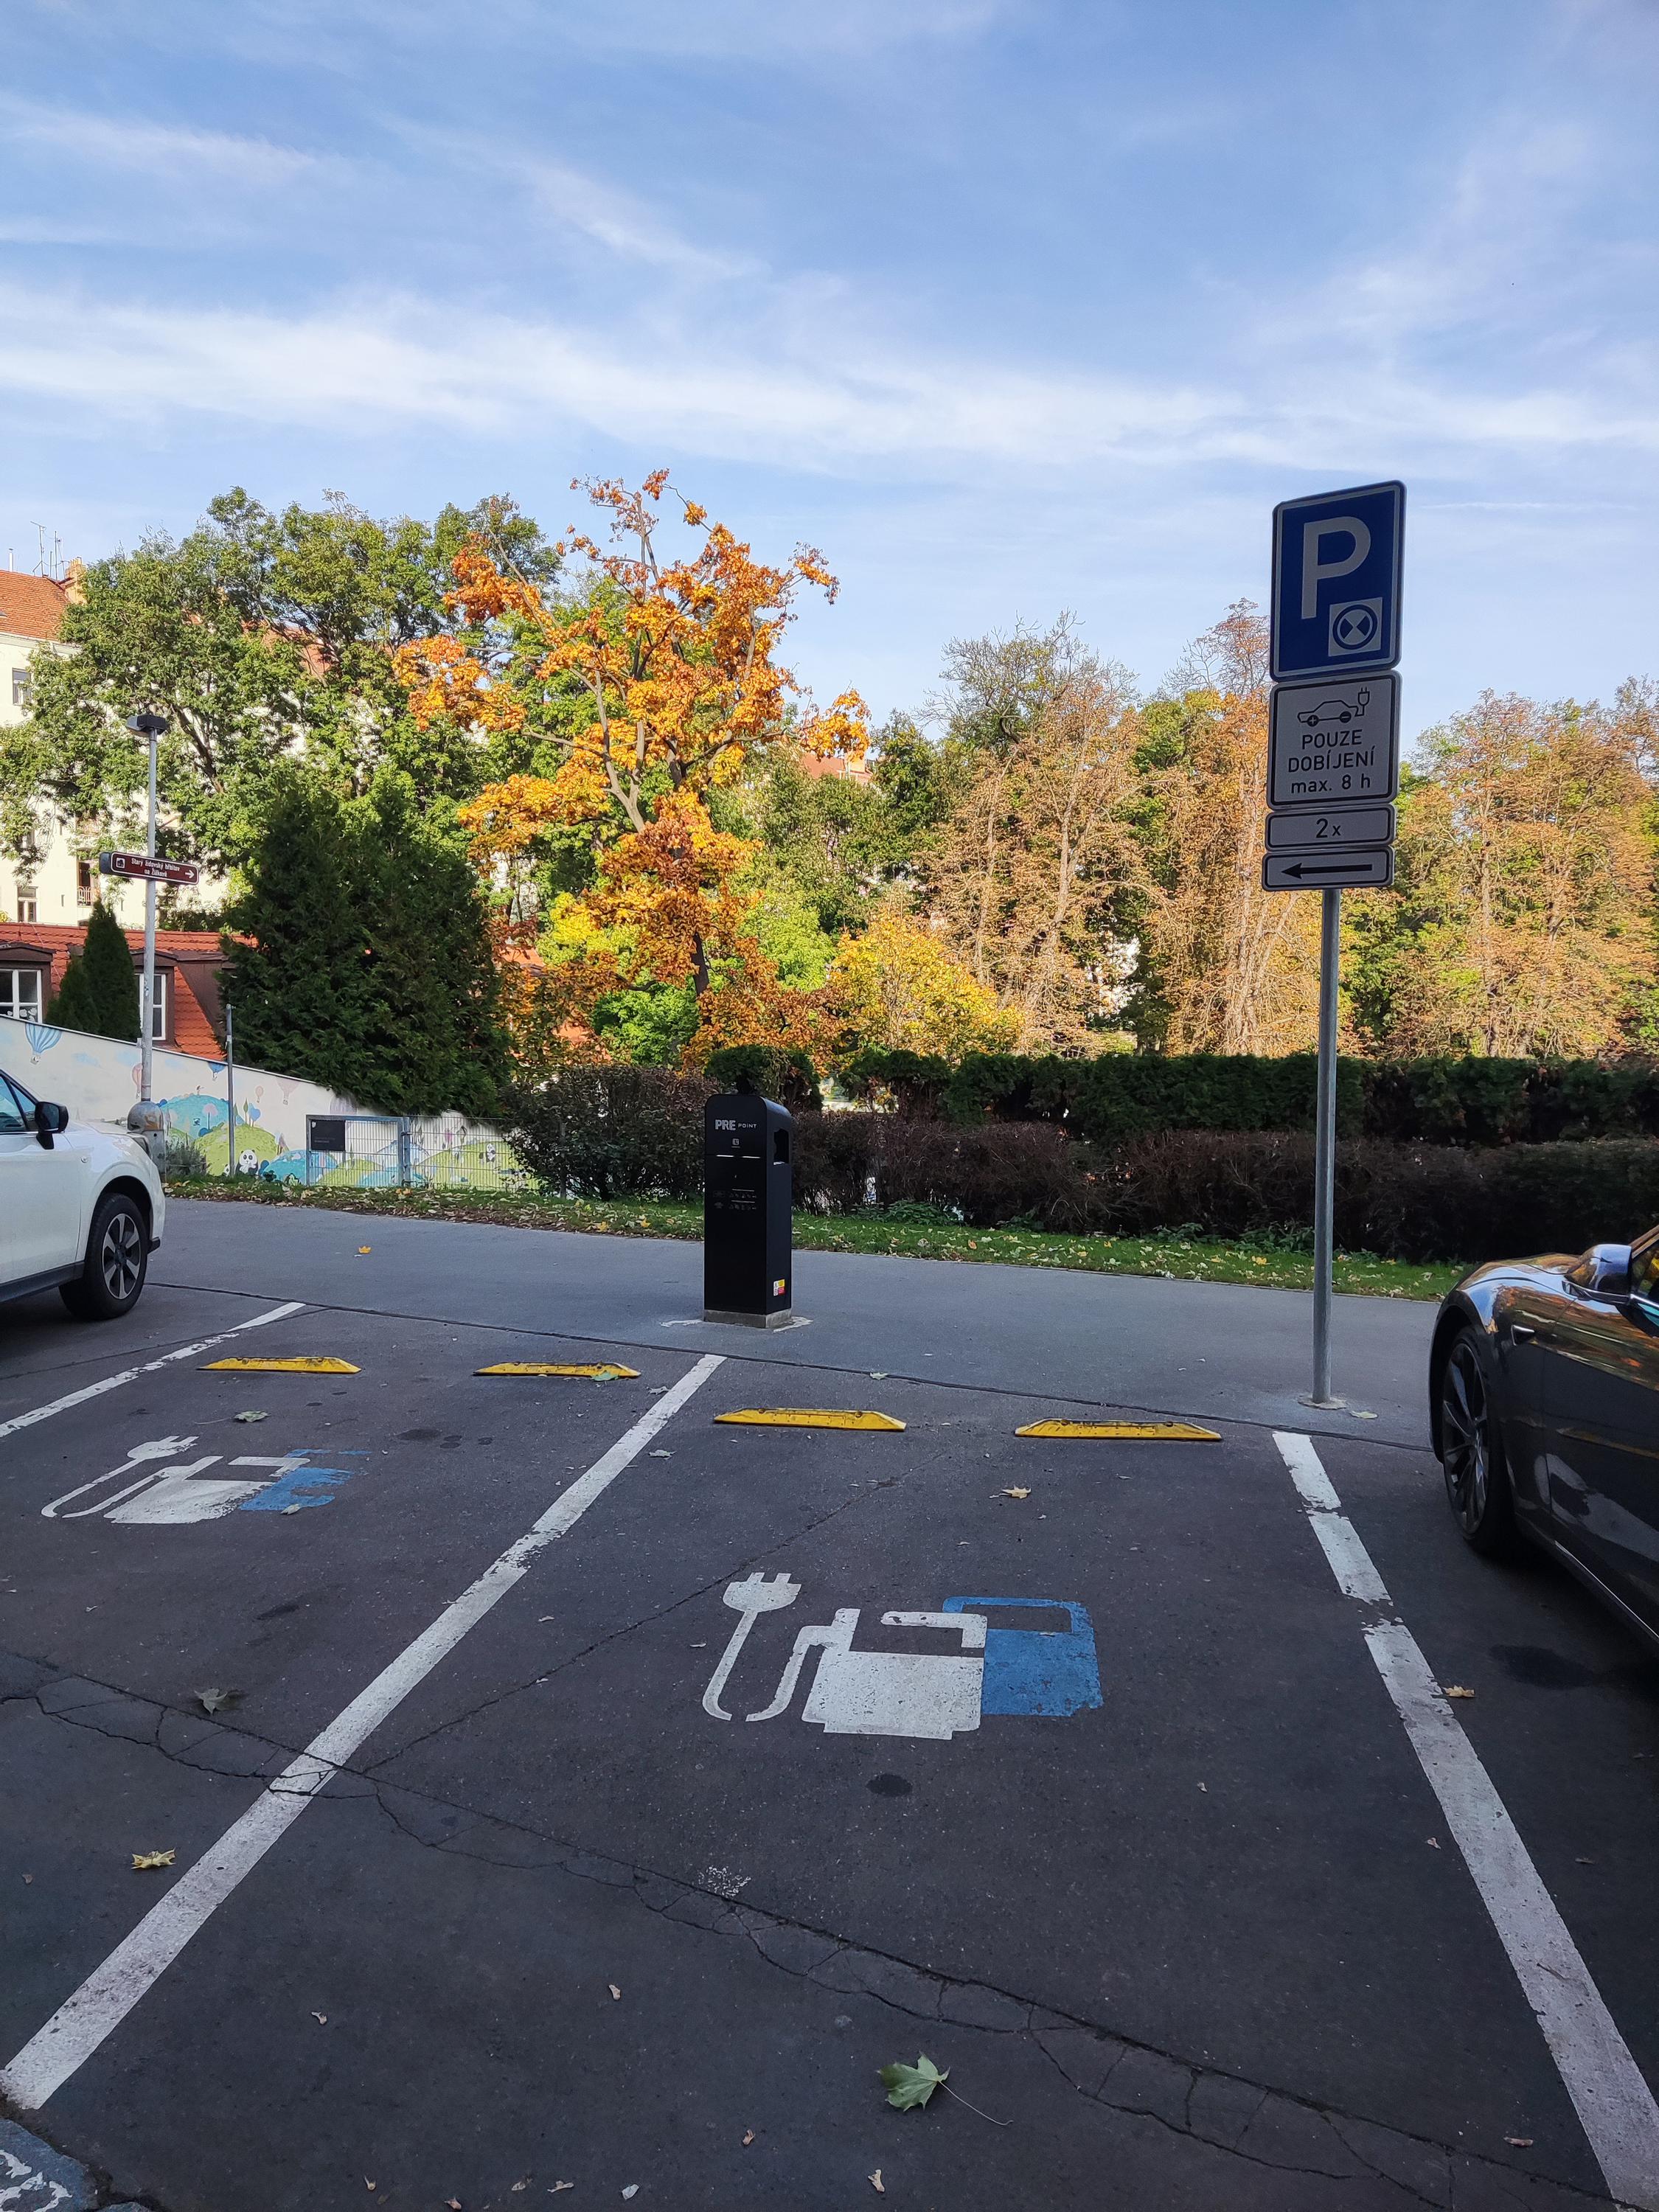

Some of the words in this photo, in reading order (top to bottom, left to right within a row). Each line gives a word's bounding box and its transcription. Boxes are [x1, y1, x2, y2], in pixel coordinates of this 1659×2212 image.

[1301, 516, 1371, 619] P
[1302, 729, 1363, 750] POUZE
[1288, 745, 1375, 773] DOBÍJENÍ
[1291, 780, 1332, 793] max.
[1342, 774, 1352, 790] 8
[1360, 773, 1371, 789] h
[131, 858, 143, 866] Starý
[714, 1119, 736, 1131] PRE
